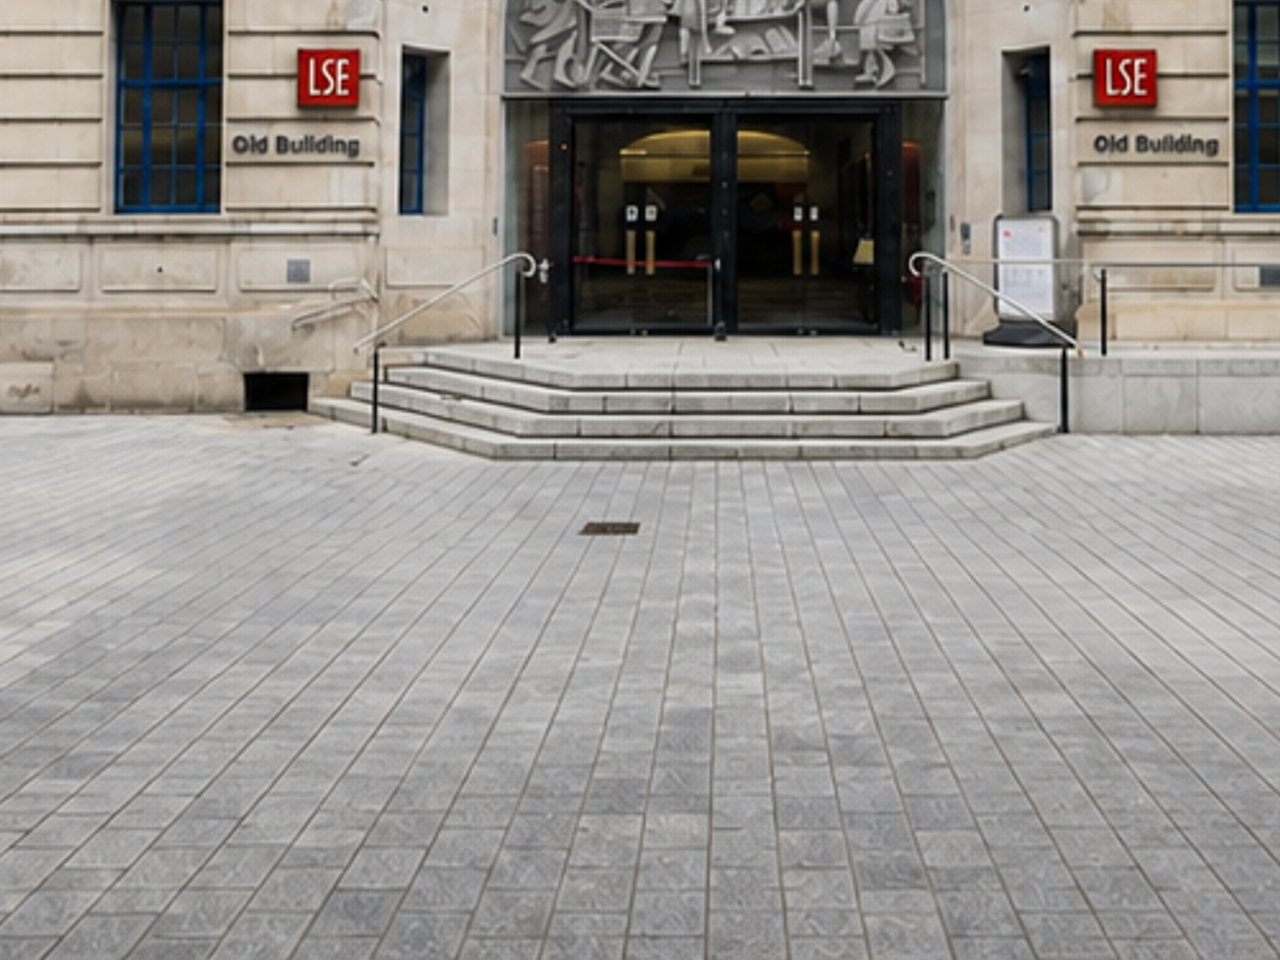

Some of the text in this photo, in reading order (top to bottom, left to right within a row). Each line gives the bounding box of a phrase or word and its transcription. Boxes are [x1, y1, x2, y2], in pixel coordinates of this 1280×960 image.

[309, 58, 350, 96] LSE
[1105, 58, 1148, 96] LSE
[232, 135, 360, 158] Old Building
[1094, 135, 1219, 157] Old Building
